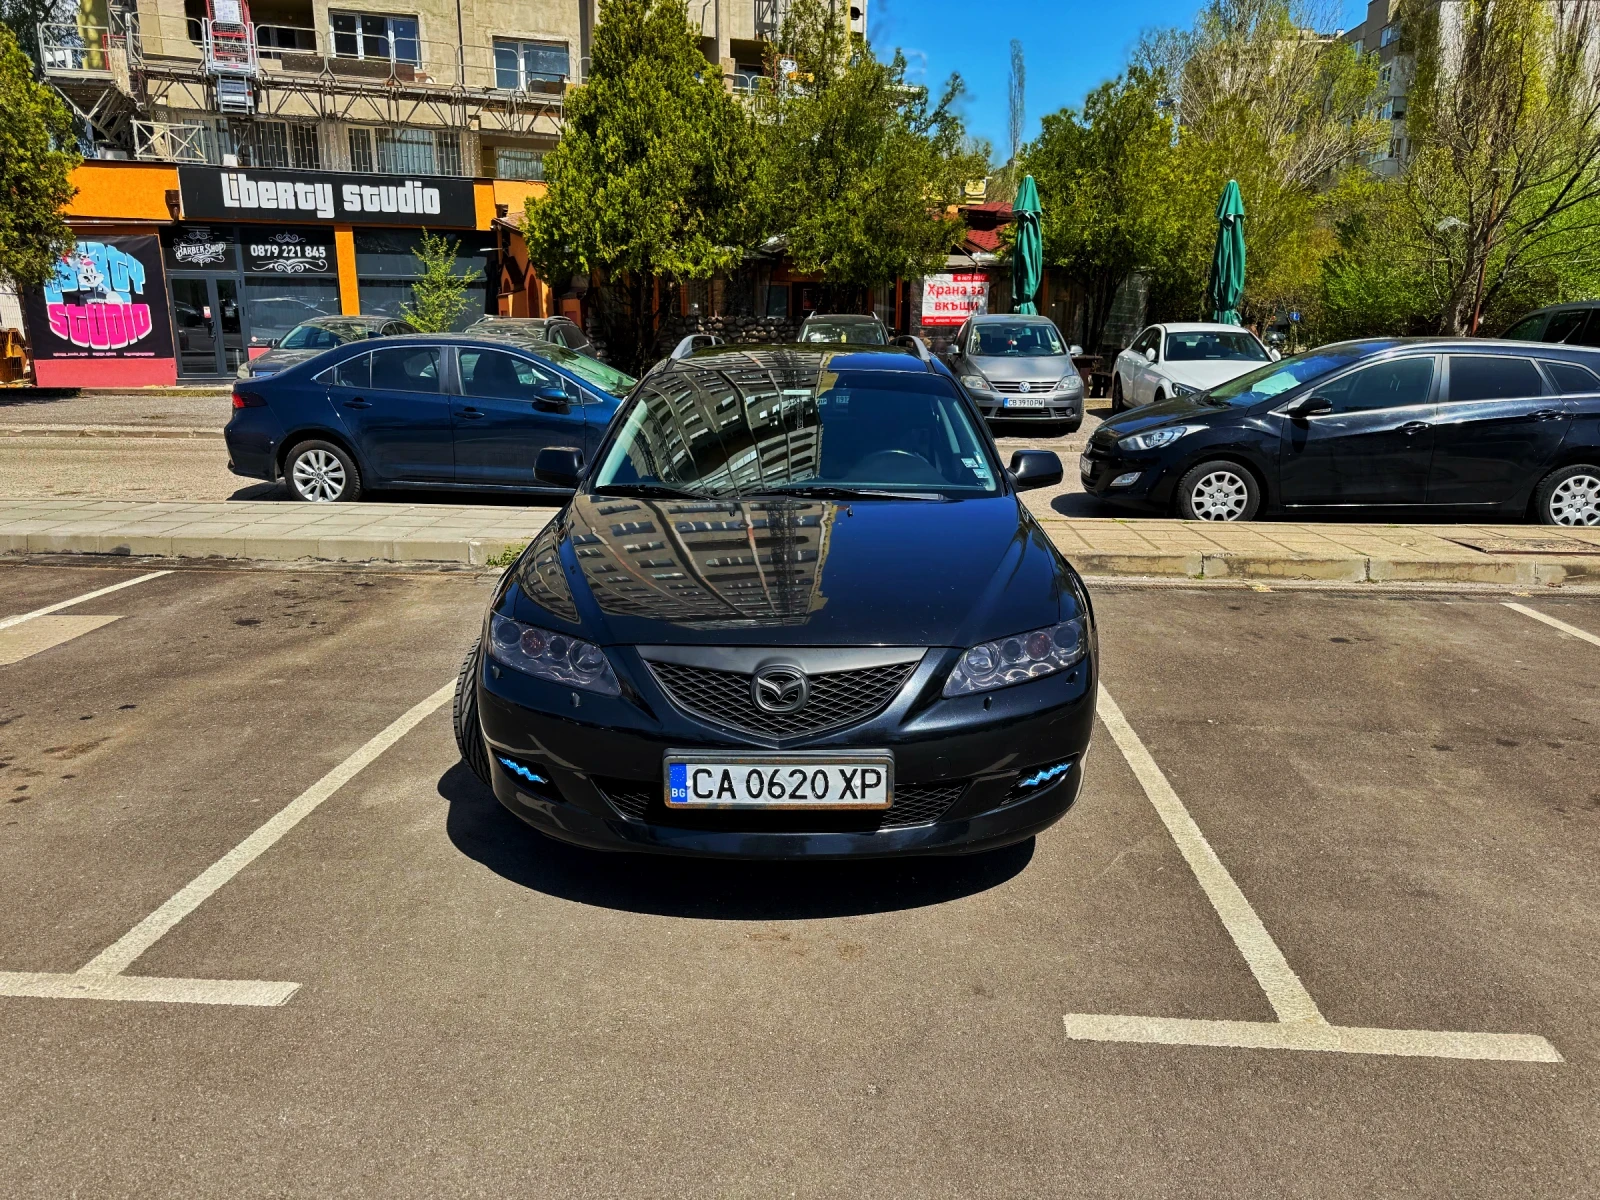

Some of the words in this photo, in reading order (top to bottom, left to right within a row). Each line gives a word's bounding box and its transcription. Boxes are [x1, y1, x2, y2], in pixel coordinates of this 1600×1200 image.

[250, 244, 280, 258] 0879
[282, 245, 303, 258] 221
[305, 245, 326, 258] 845
[927, 283, 967, 299] Храна
[971, 285, 985, 296] за
[934, 301, 979, 313] вкъщи
[692, 768, 737, 800] CA
[745, 768, 830, 800] 0620
[838, 768, 883, 800] XP
[671, 788, 686, 798] BG
